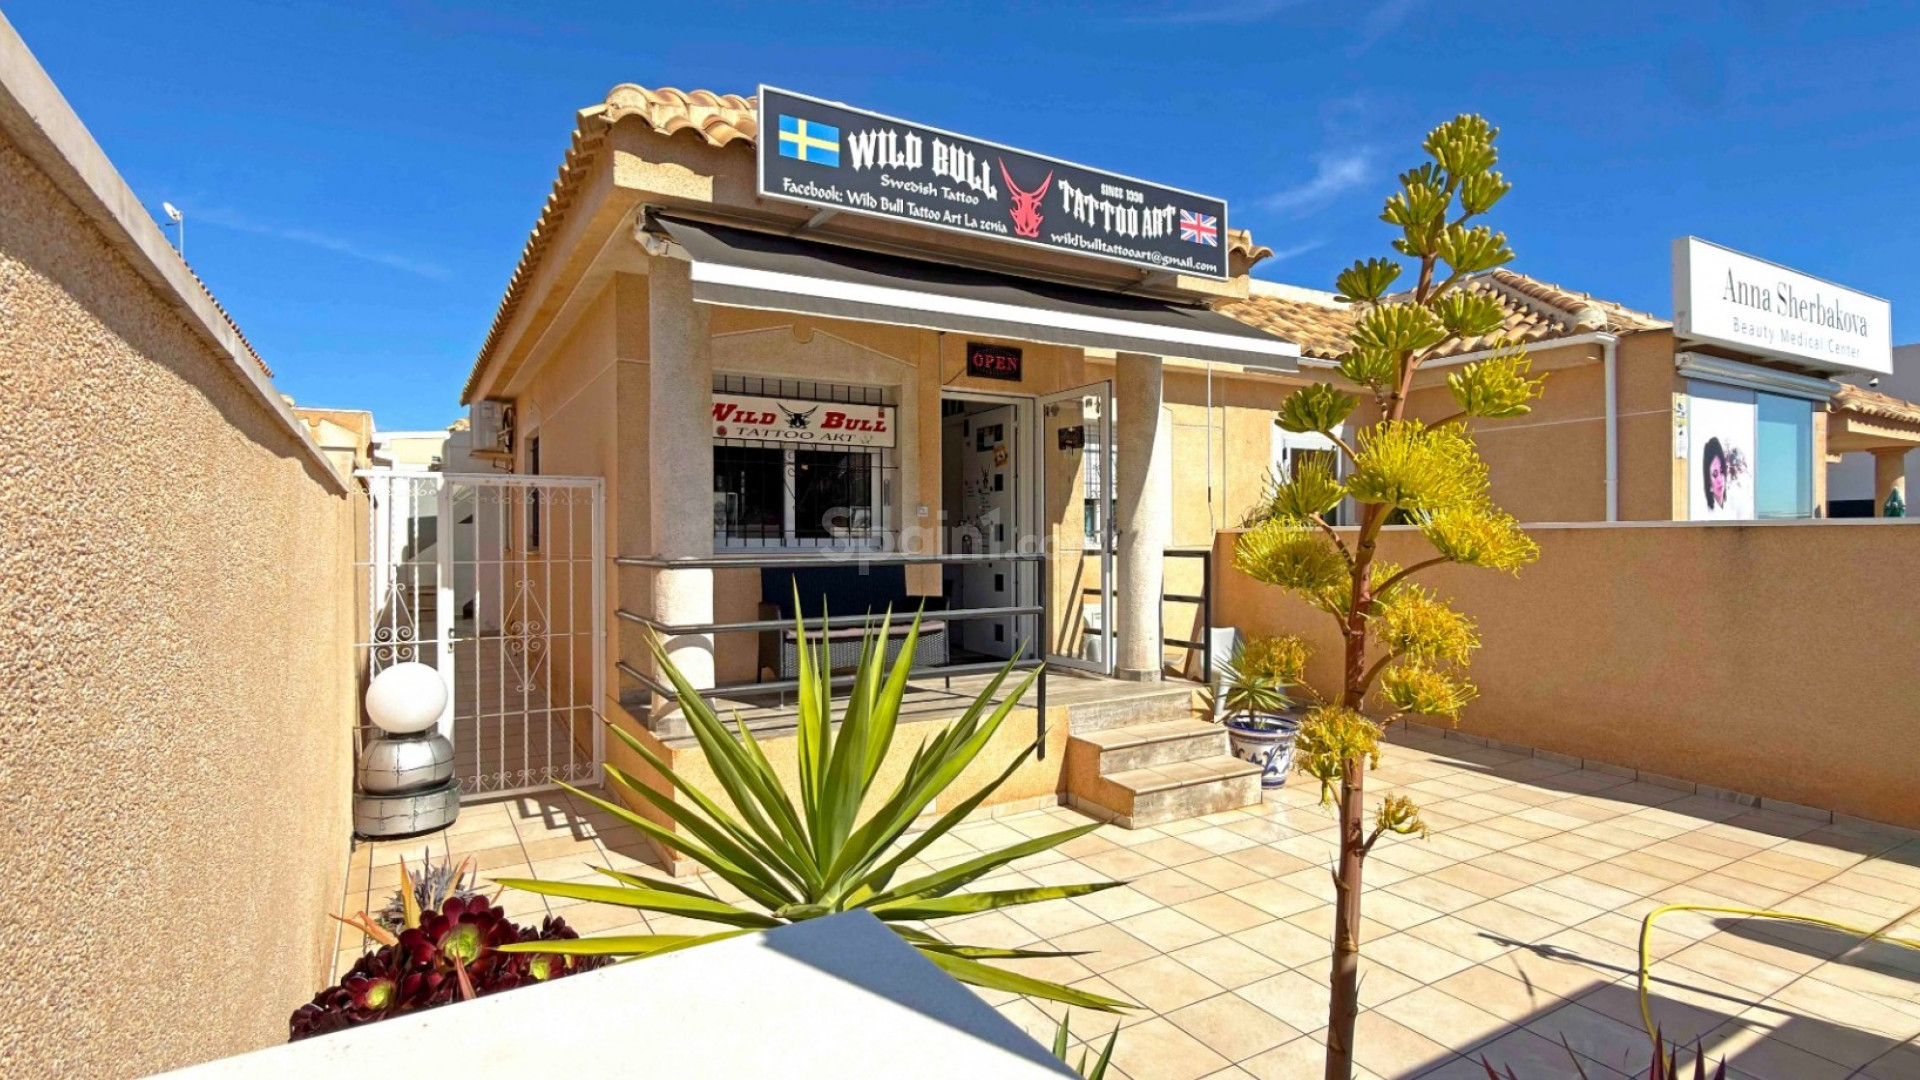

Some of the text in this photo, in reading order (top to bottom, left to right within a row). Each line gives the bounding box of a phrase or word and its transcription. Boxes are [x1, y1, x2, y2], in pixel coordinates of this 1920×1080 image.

[848, 128, 998, 201] WILD BULL
[783, 177, 1008, 234] Facebook: Wild Bull Tattoo Art La zenia
[881, 174, 979, 205] Swedish Tattoo
[1058, 179, 1176, 239] TATTOO ART
[1100, 182, 1124, 199] SINCE
[1050, 232, 1217, 273] wildbulltattooart@gmail.com
[1722, 266, 1868, 337] Anna Sherbakova
[1732, 316, 1860, 359] Beauty Medical Center
[972, 352, 1018, 371] OPEN
[736, 426, 856, 442] TATTOO ART
